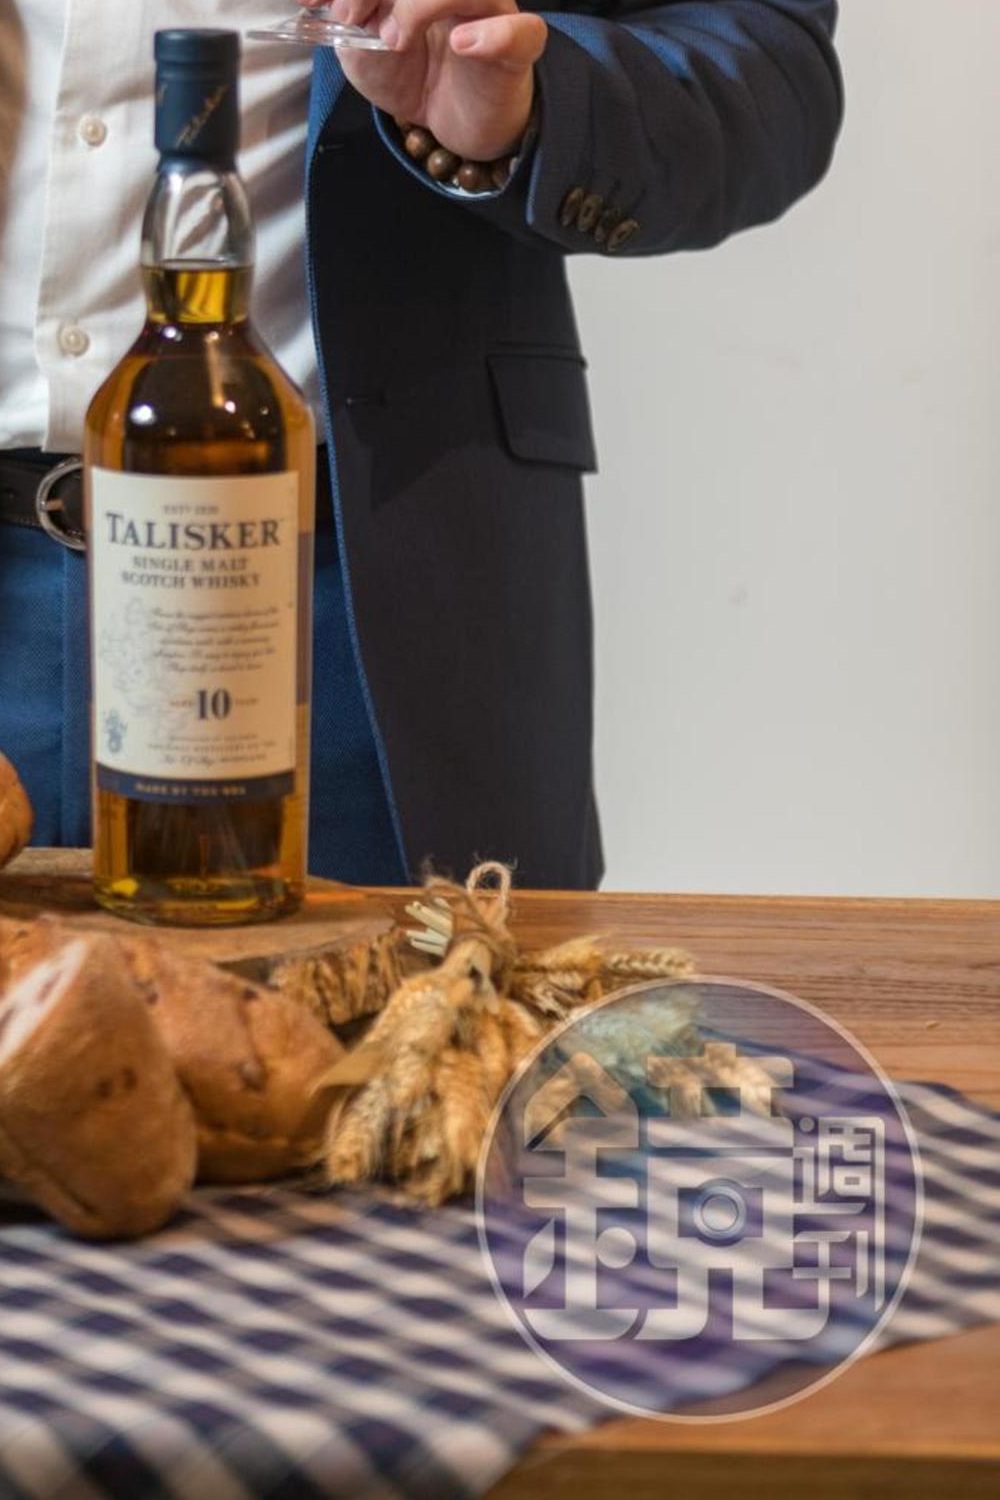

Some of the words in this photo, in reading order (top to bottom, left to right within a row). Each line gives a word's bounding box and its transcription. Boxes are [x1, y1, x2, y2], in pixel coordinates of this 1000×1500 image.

[106, 511, 281, 551] TALISKER
[133, 556, 194, 572] SINGLE
[202, 557, 248, 572] MALT
[121, 571, 185, 588] SCOTCH
[192, 572, 260, 589] WHISKY
[197, 688, 232, 720] 10
